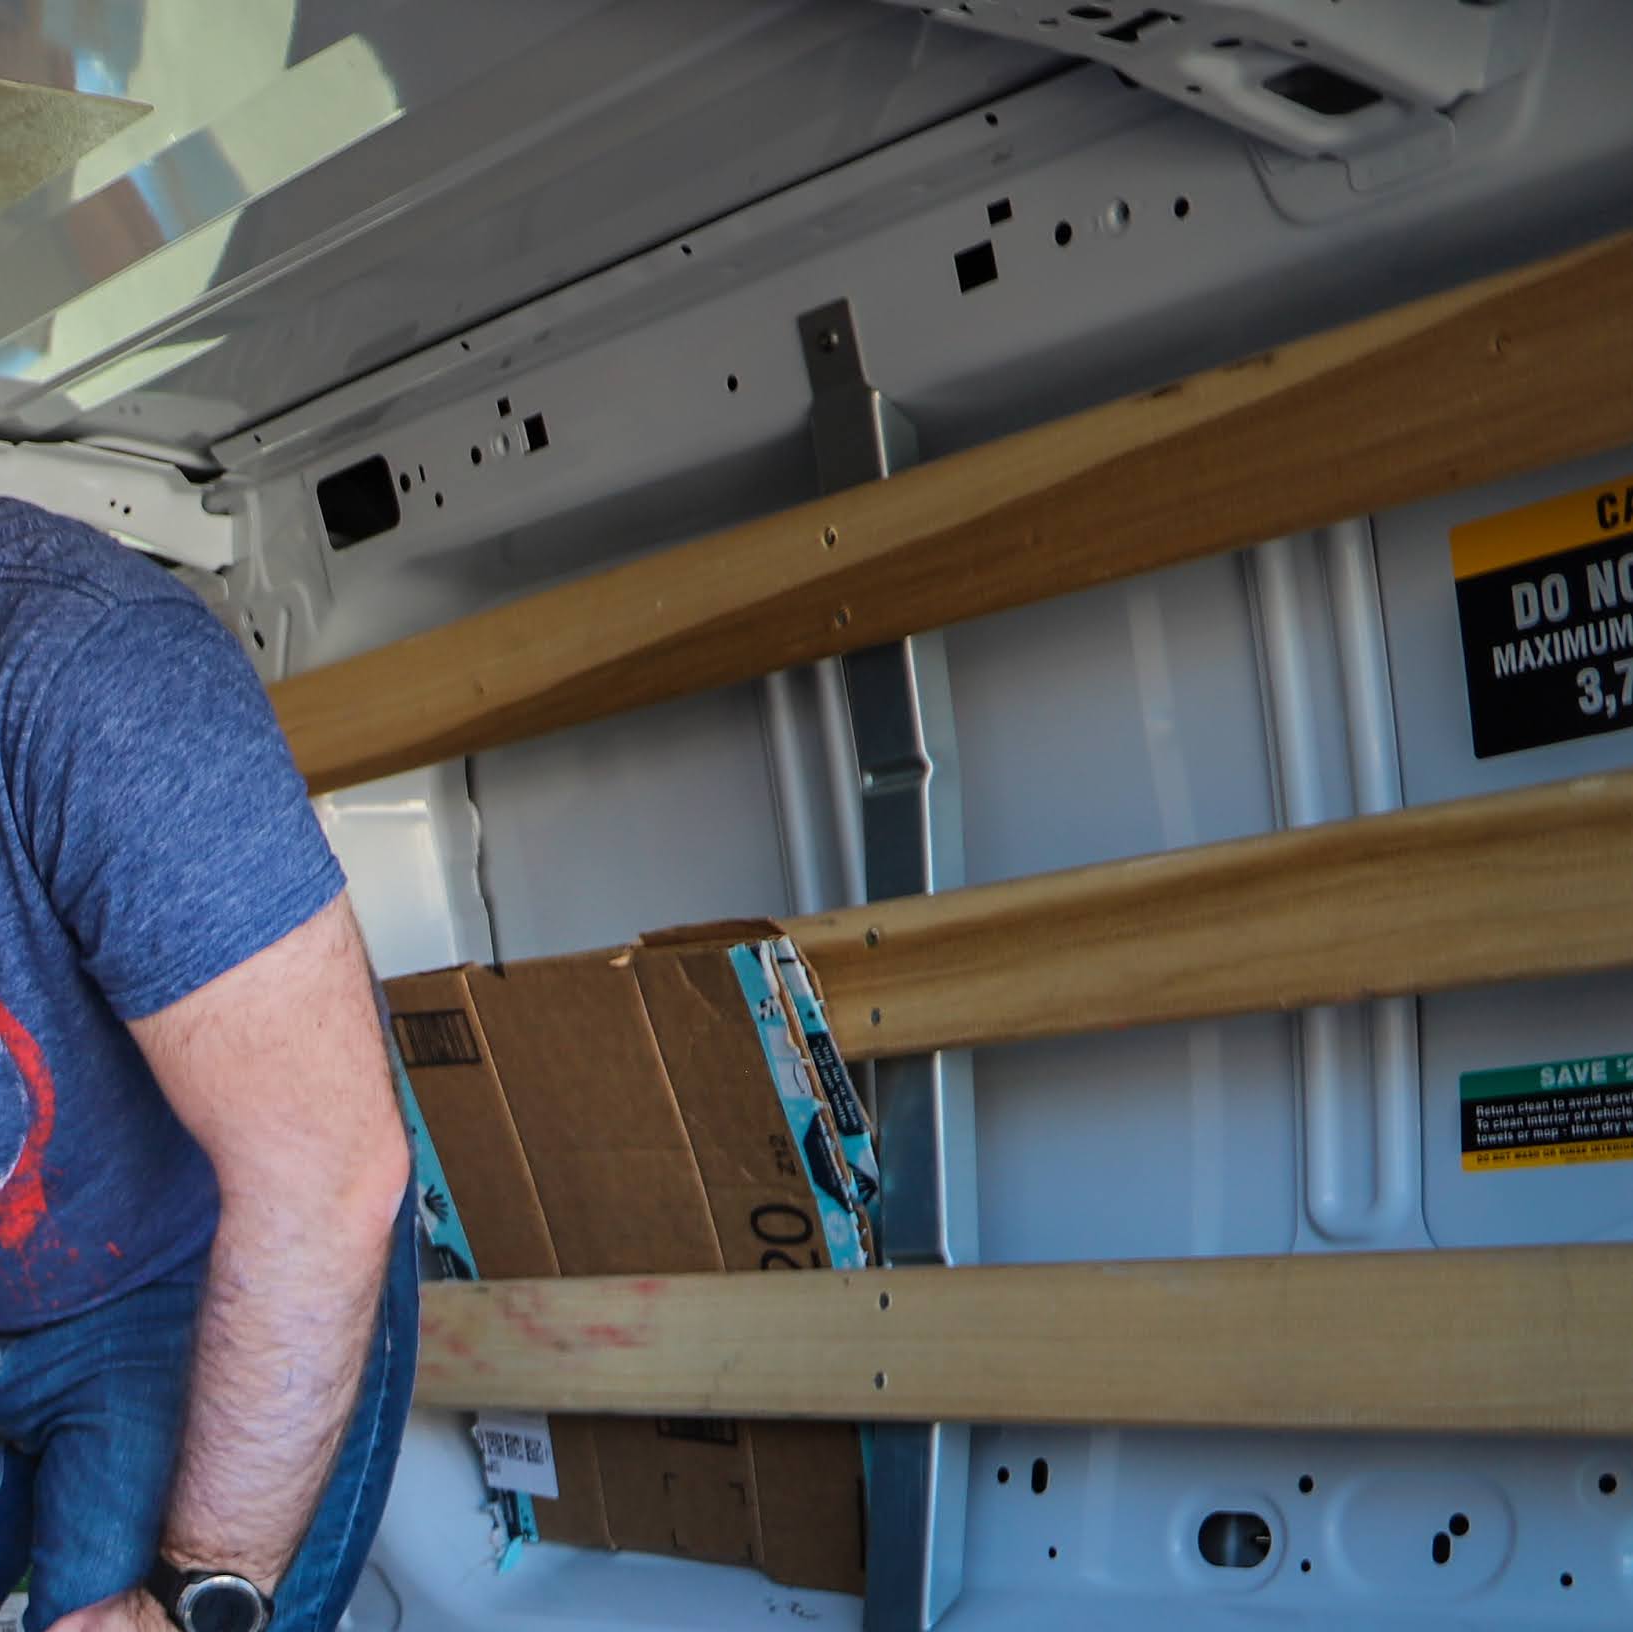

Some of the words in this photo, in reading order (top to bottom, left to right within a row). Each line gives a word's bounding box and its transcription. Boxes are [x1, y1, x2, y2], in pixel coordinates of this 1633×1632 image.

[1511, 573, 1569, 631] DO
[1493, 613, 1633, 679] MAXIMUM
[1540, 1059, 1607, 1089] SAVE
[1476, 1104, 1514, 1117] Return
[1518, 1100, 1549, 1112] clean
[1554, 1098, 1564, 1110] to
[1569, 1094, 1601, 1108] avoid
[1476, 1118, 1489, 1131] To
[1493, 1115, 1523, 1129] clean
[1527, 1112, 1570, 1126] interior
[1574, 1110, 1585, 1121] of
